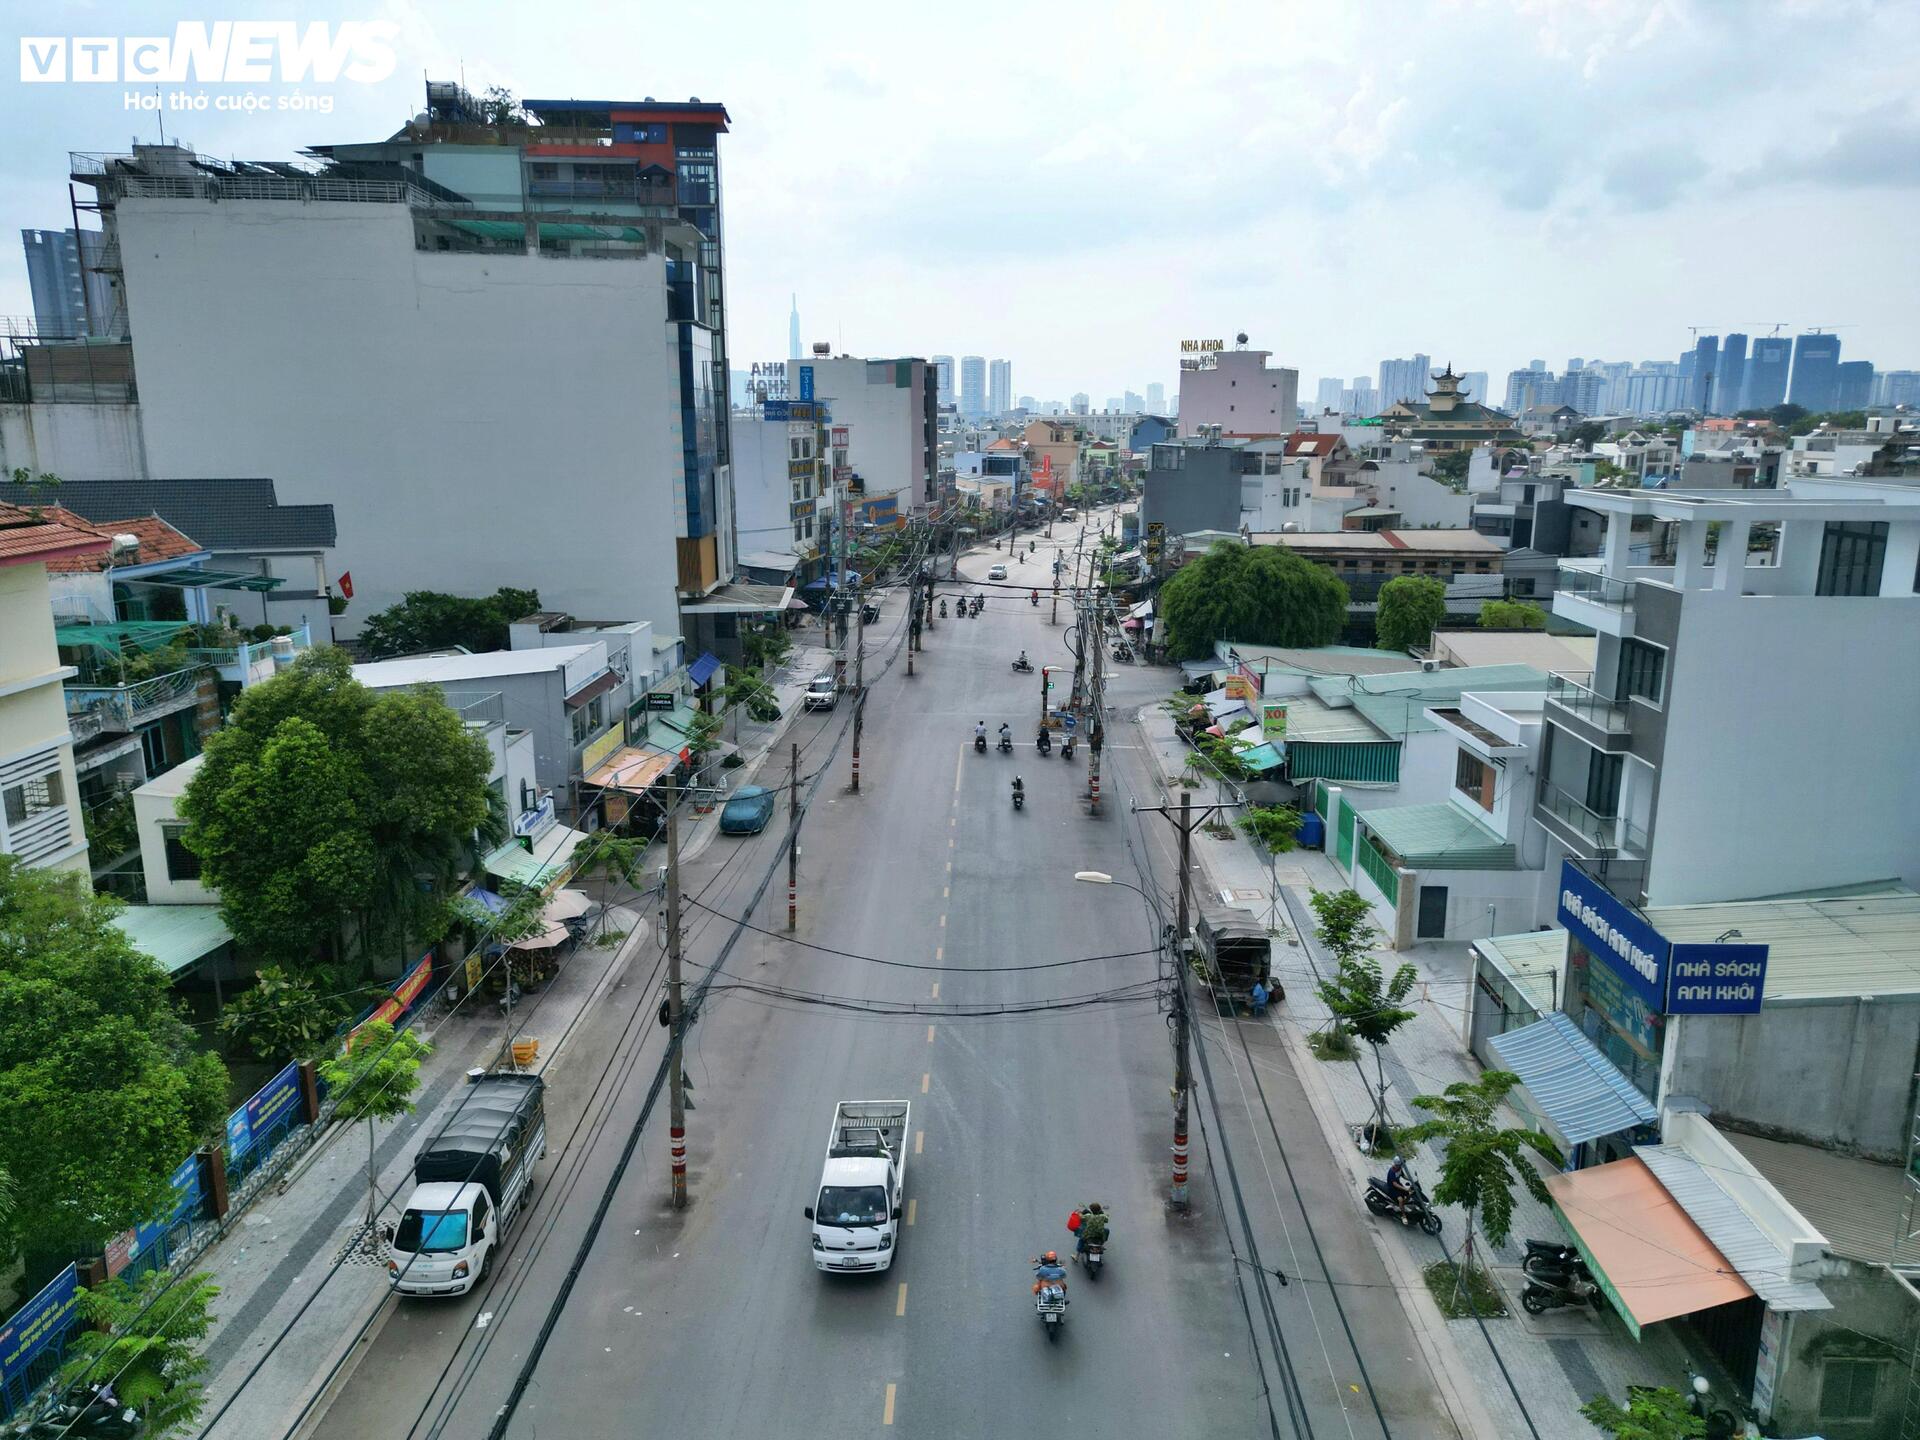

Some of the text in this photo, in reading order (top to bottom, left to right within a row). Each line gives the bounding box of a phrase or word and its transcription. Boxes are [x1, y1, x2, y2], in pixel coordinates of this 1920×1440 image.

[1582, 906, 1610, 942] SÁCH
[1676, 962, 1761, 977] NHÀ SÁCH
[1678, 984, 1755, 1000] ANH KHÔI
